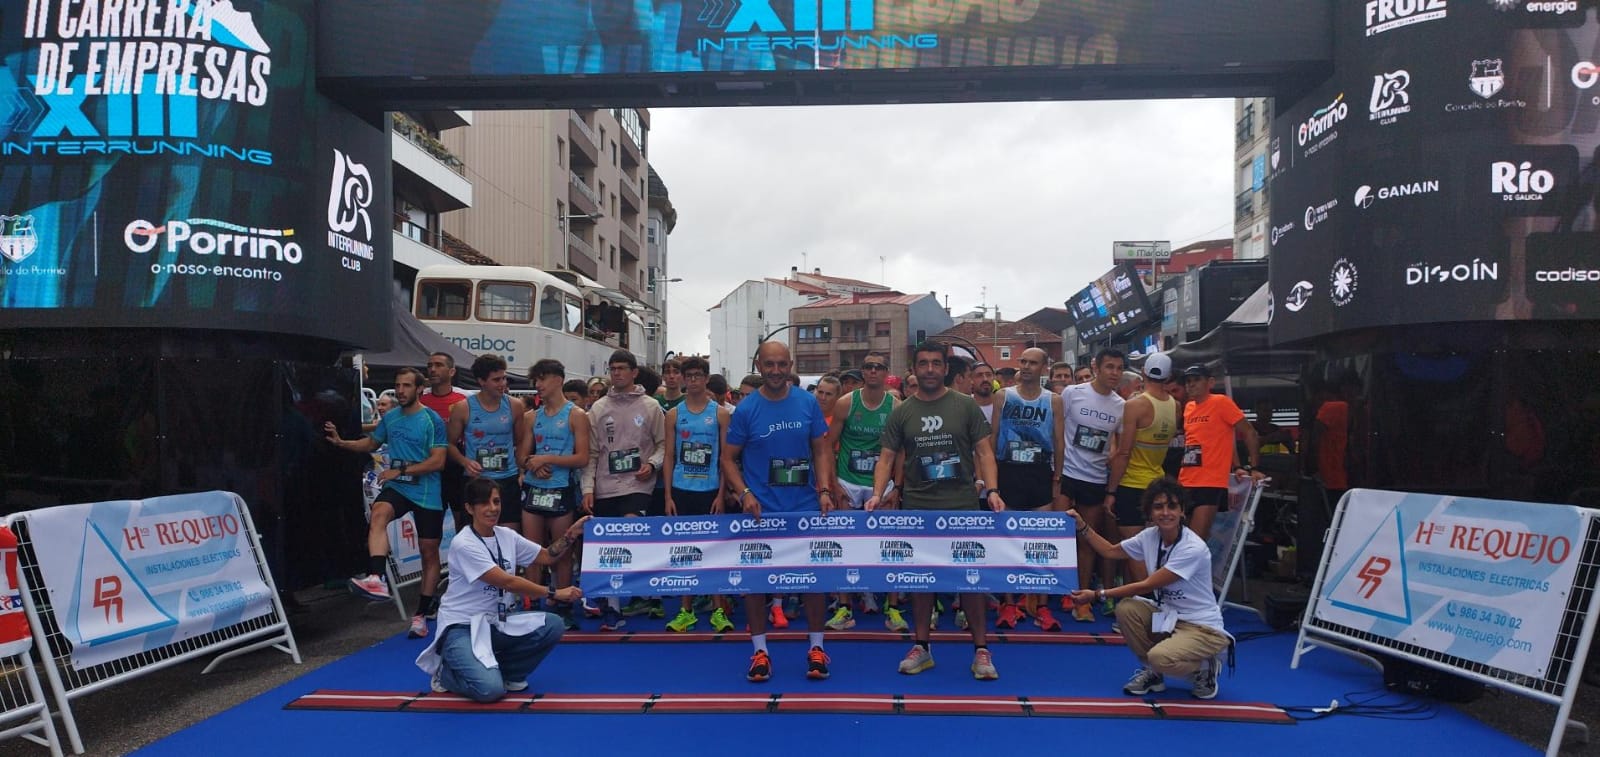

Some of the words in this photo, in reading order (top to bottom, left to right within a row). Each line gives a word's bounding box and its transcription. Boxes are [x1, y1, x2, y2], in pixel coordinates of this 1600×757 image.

[25, 0, 49, 38] II
[57, 0, 213, 41] CARRERA
[697, 33, 938, 53] INTERRUNNING
[35, 42, 80, 97] DE
[85, 43, 271, 107] EMPRESAS
[27, 73, 198, 138] XIII
[1298, 122, 1307, 146] O
[3, 140, 273, 166] INTERRUNNING
[1491, 161, 1554, 194] Río
[1378, 180, 1439, 199] GANAIN
[124, 219, 158, 253] O
[327, 231, 374, 260] INTERRUNNING
[342, 257, 361, 272] CLUB
[440, 332, 516, 352] maboc
[1012, 406, 1047, 422] ADN
[1080, 407, 1116, 424] snop
[761, 420, 802, 437] galicia
[615, 458, 633, 471] 317
[684, 449, 706, 463] 563
[785, 470, 793, 483] 1
[936, 465, 946, 478] 2
[155, 513, 239, 546] REQUEJO
[605, 522, 651, 533] acero+
[674, 521, 719, 532] acero+
[810, 516, 855, 526] acero+
[878, 516, 925, 526] acero+
[948, 516, 995, 526] acero+
[1019, 517, 1066, 527] acero+
[604, 547, 626, 555] CARRERA
[674, 546, 696, 554] CARRERA
[744, 543, 765, 551] CARRERA
[814, 541, 835, 549] CARRERA
[884, 541, 905, 549] CARRERA
[956, 541, 977, 550] CARRERA
[1028, 542, 1050, 551] CARRERA
[1450, 525, 1571, 565] REQUEJO
[146, 557, 200, 576] INSTALACIONES
[203, 549, 241, 564] ELECTRICAS
[650, 577, 659, 587] O
[768, 574, 777, 584] O
[886, 573, 895, 583] O
[1007, 574, 1016, 584] O
[1418, 561, 1485, 582] INSTALACIONES
[1489, 573, 1550, 593] ELECTRICAS
[1459, 606, 1477, 622] 986
[1479, 610, 1492, 625] 34
[1495, 613, 1507, 628] 30
[1508, 616, 1523, 630] 02
[1427, 620, 1532, 653] www.hrequejo.com
